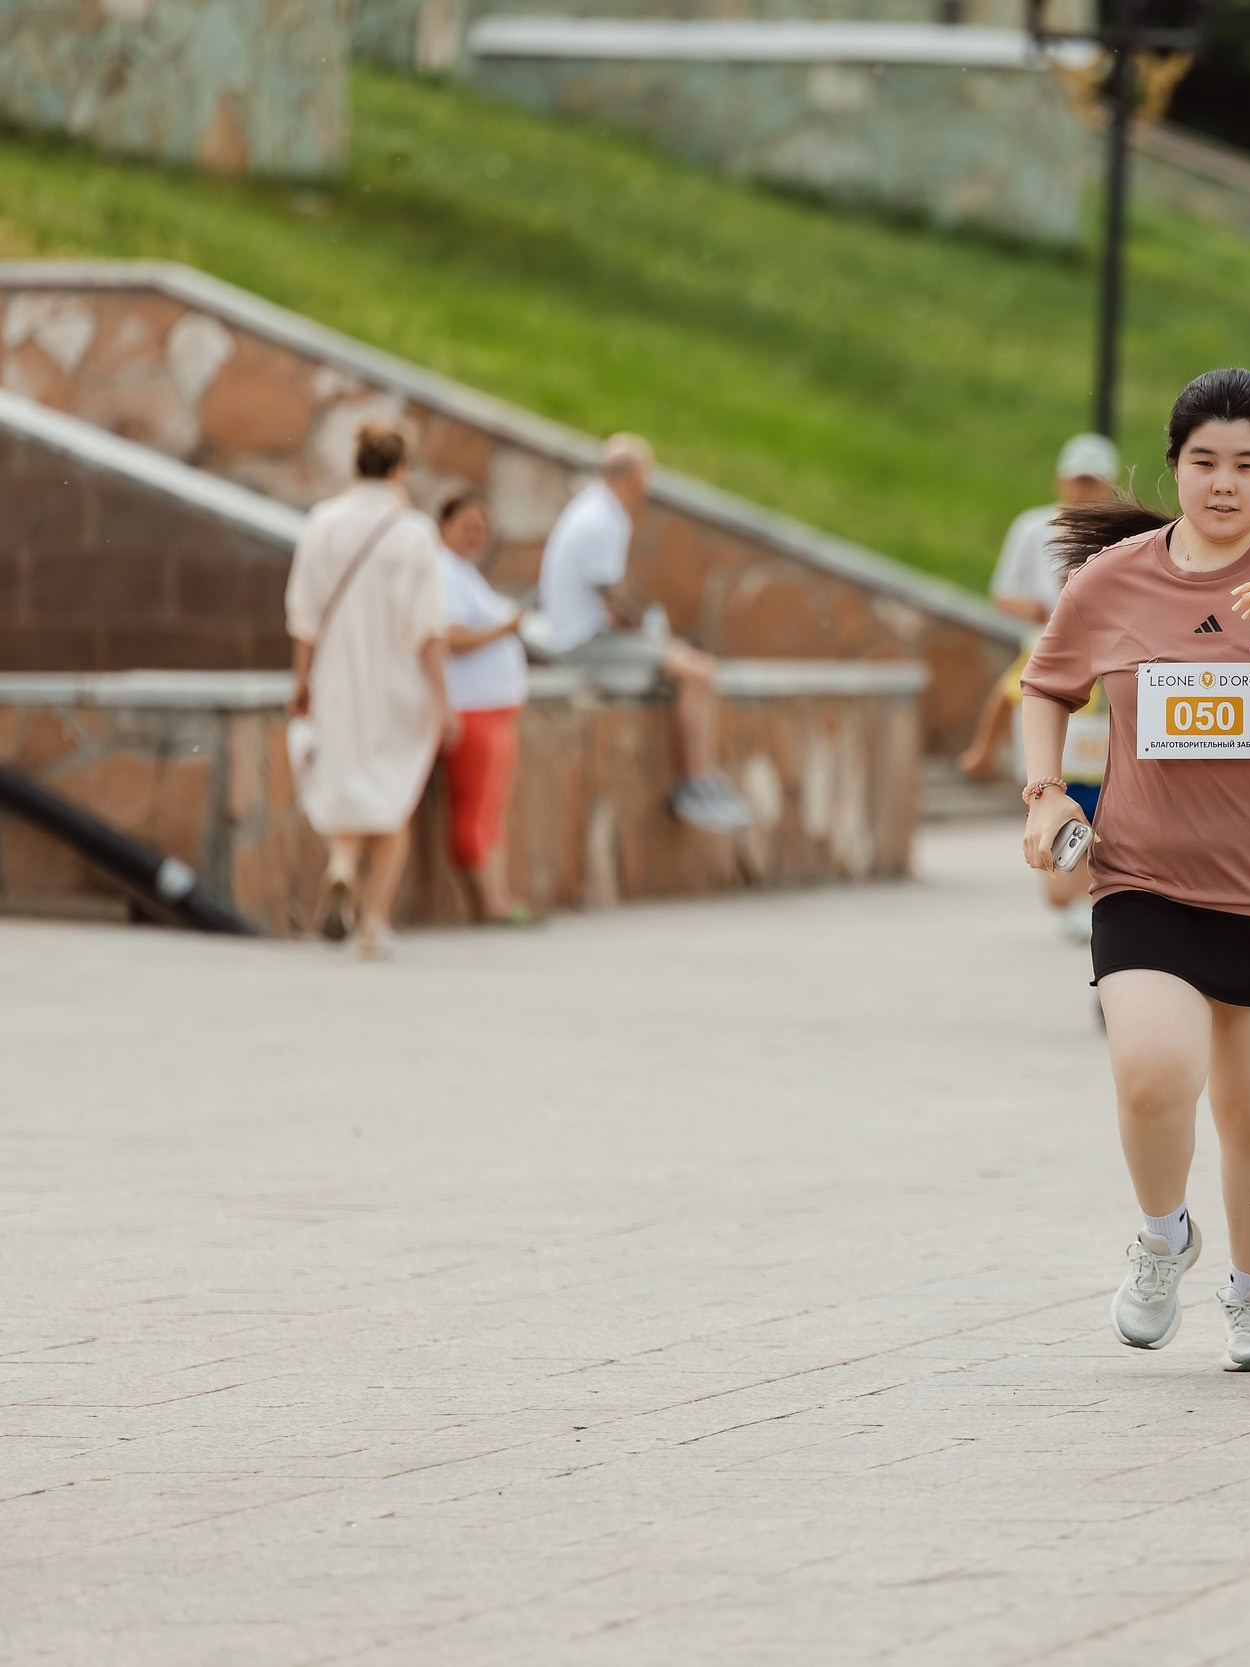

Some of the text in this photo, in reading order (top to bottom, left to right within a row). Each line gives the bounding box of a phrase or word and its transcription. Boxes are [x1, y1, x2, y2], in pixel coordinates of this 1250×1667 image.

[1150, 675, 1195, 687] LEONE
[1173, 701, 1235, 731] 050
[1150, 740, 1235, 748] БЛАГОТВОРИТЕЛЬНЫЙ
